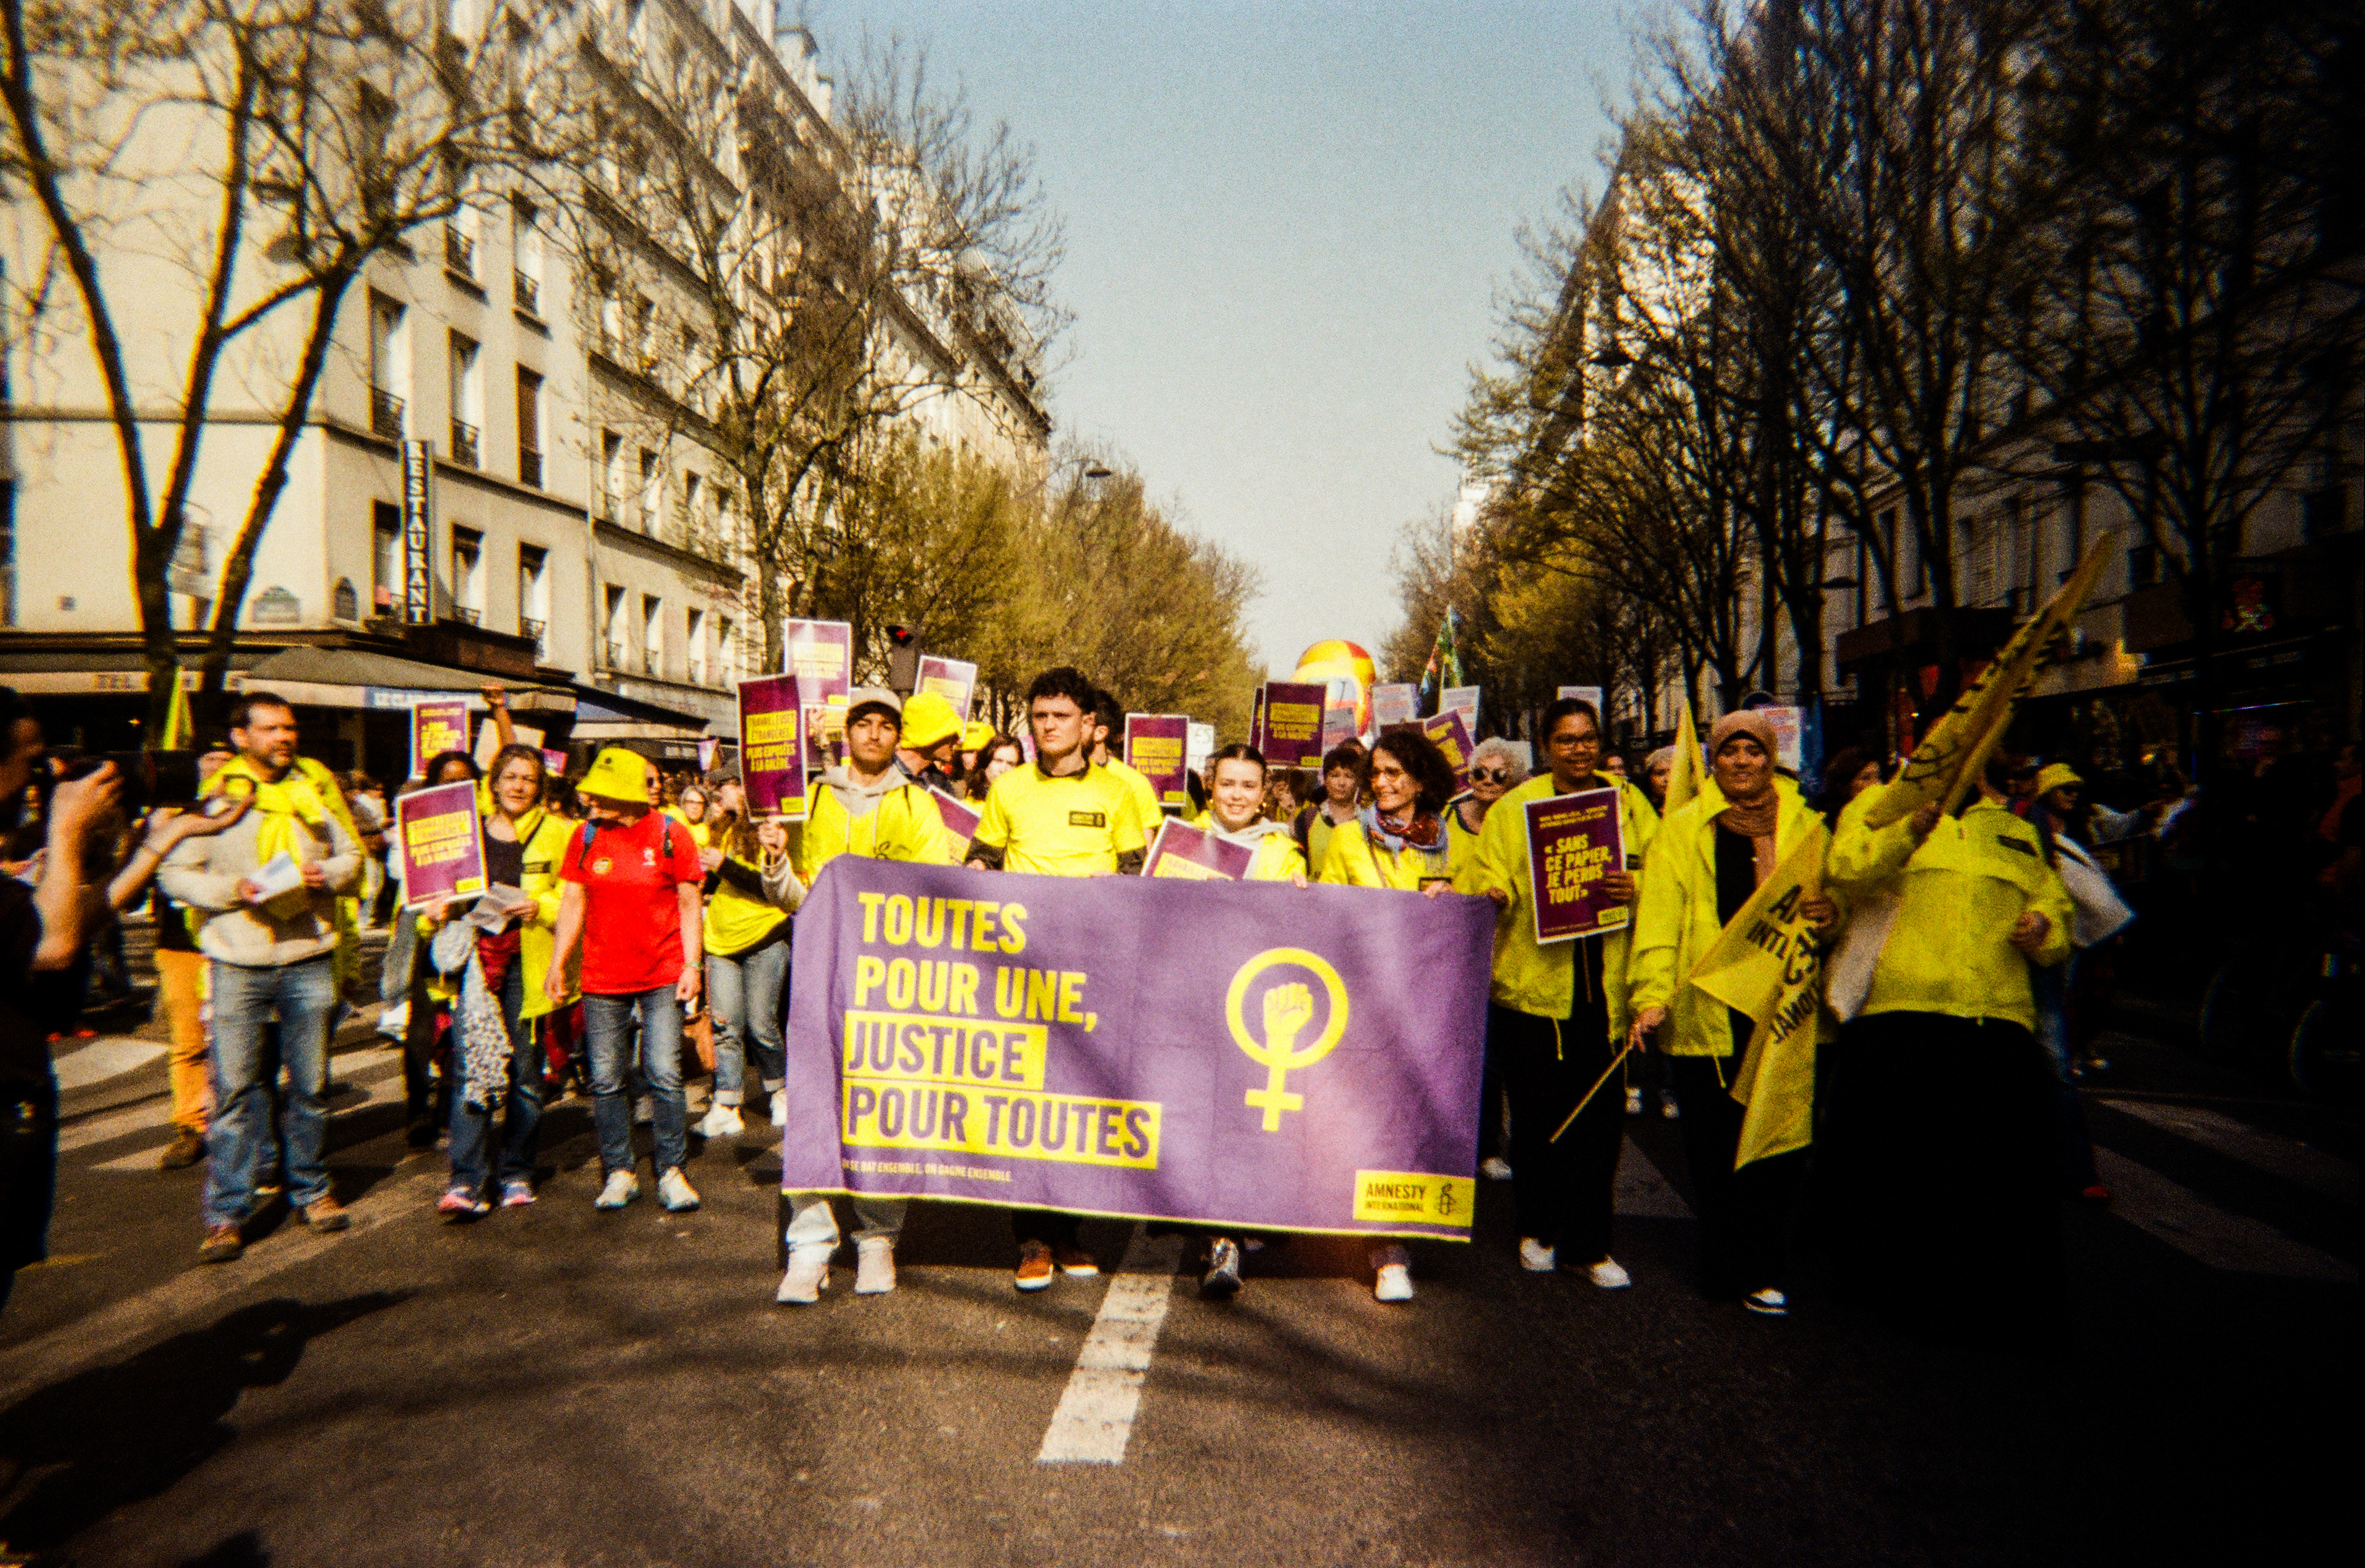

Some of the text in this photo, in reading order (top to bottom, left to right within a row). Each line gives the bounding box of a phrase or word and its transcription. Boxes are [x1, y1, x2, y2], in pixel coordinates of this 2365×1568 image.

[1545, 855, 1563, 871] CE
[1546, 871, 1561, 888] JE
[858, 892, 1028, 955] TOUTES
[854, 955, 1098, 1032] POUR UNE,
[847, 1020, 1027, 1083] JUSTICE
[847, 1085, 1150, 1160] POUR TOUTES
[1364, 1200, 1424, 1213] INTERNATIONAL
[1365, 1182, 1426, 1200] AMNESTY
